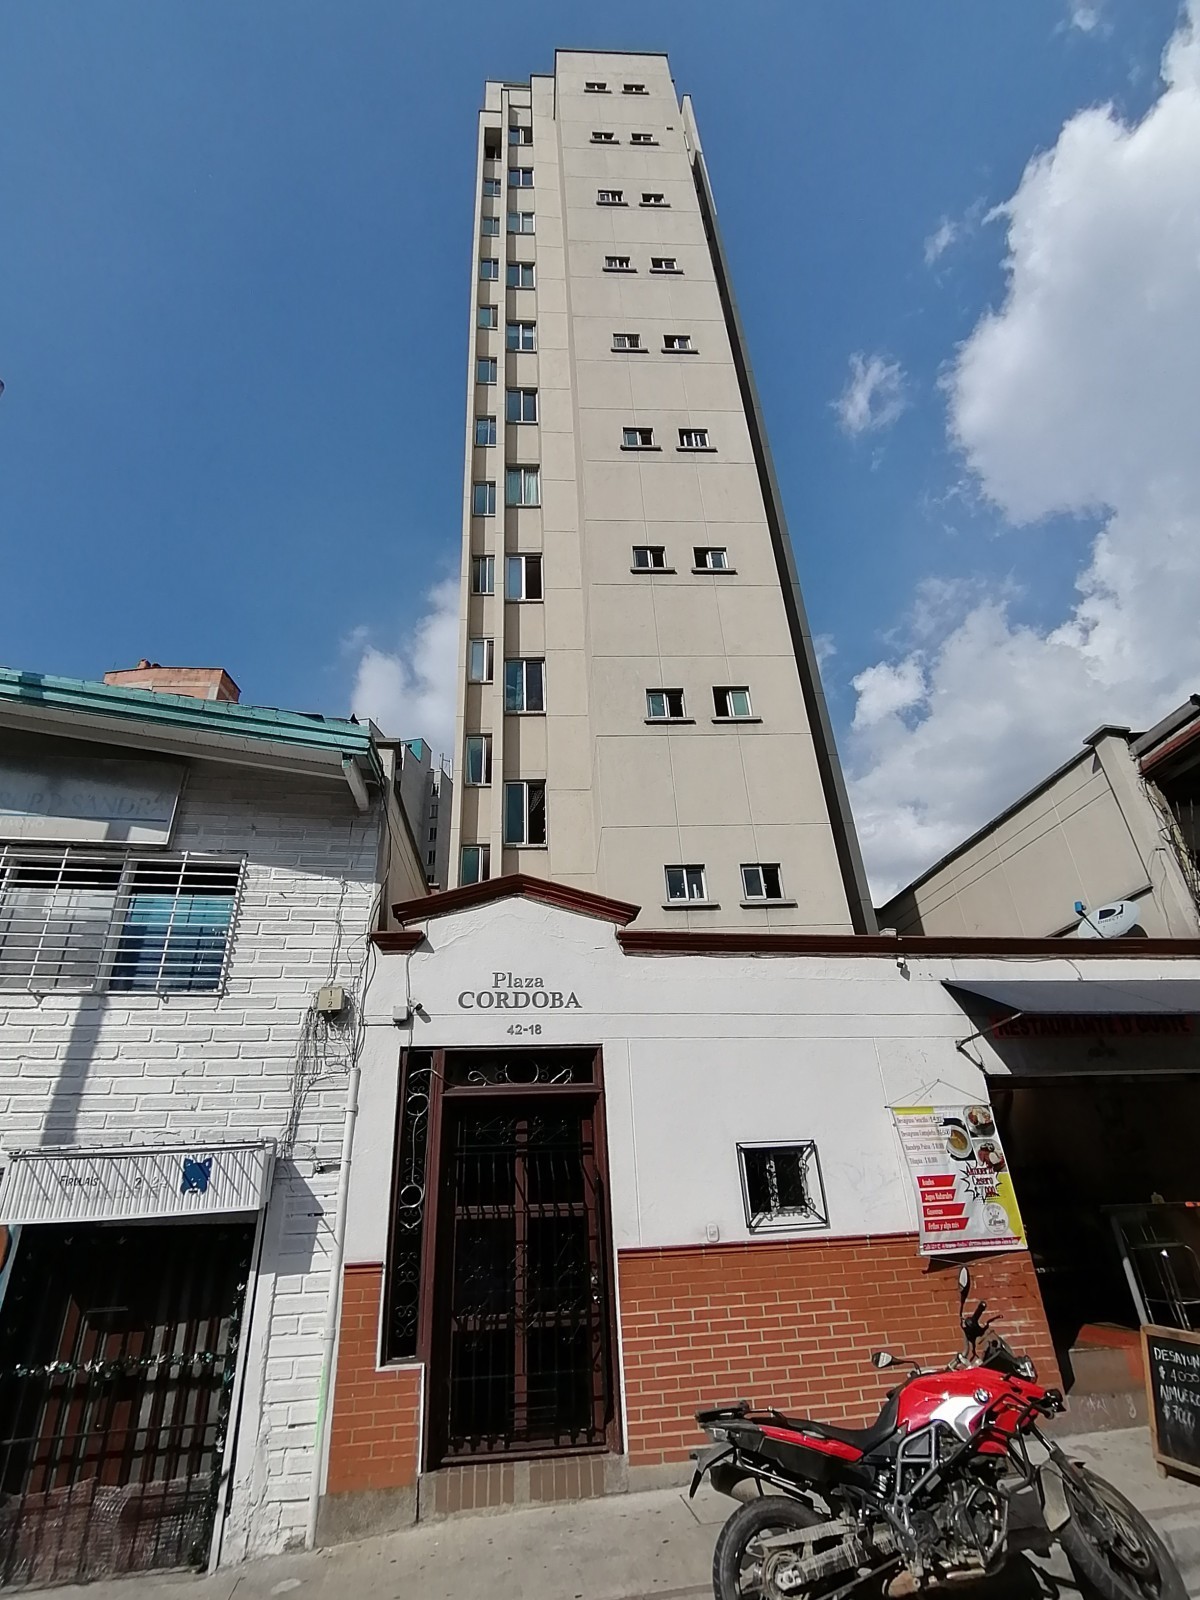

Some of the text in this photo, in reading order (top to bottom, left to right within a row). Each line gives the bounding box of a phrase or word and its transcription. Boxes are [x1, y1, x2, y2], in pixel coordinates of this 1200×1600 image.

[491, 972, 545, 989] Plaza
[457, 990, 583, 1009] CORDOBA
[506, 1024, 542, 1036] 42-18
